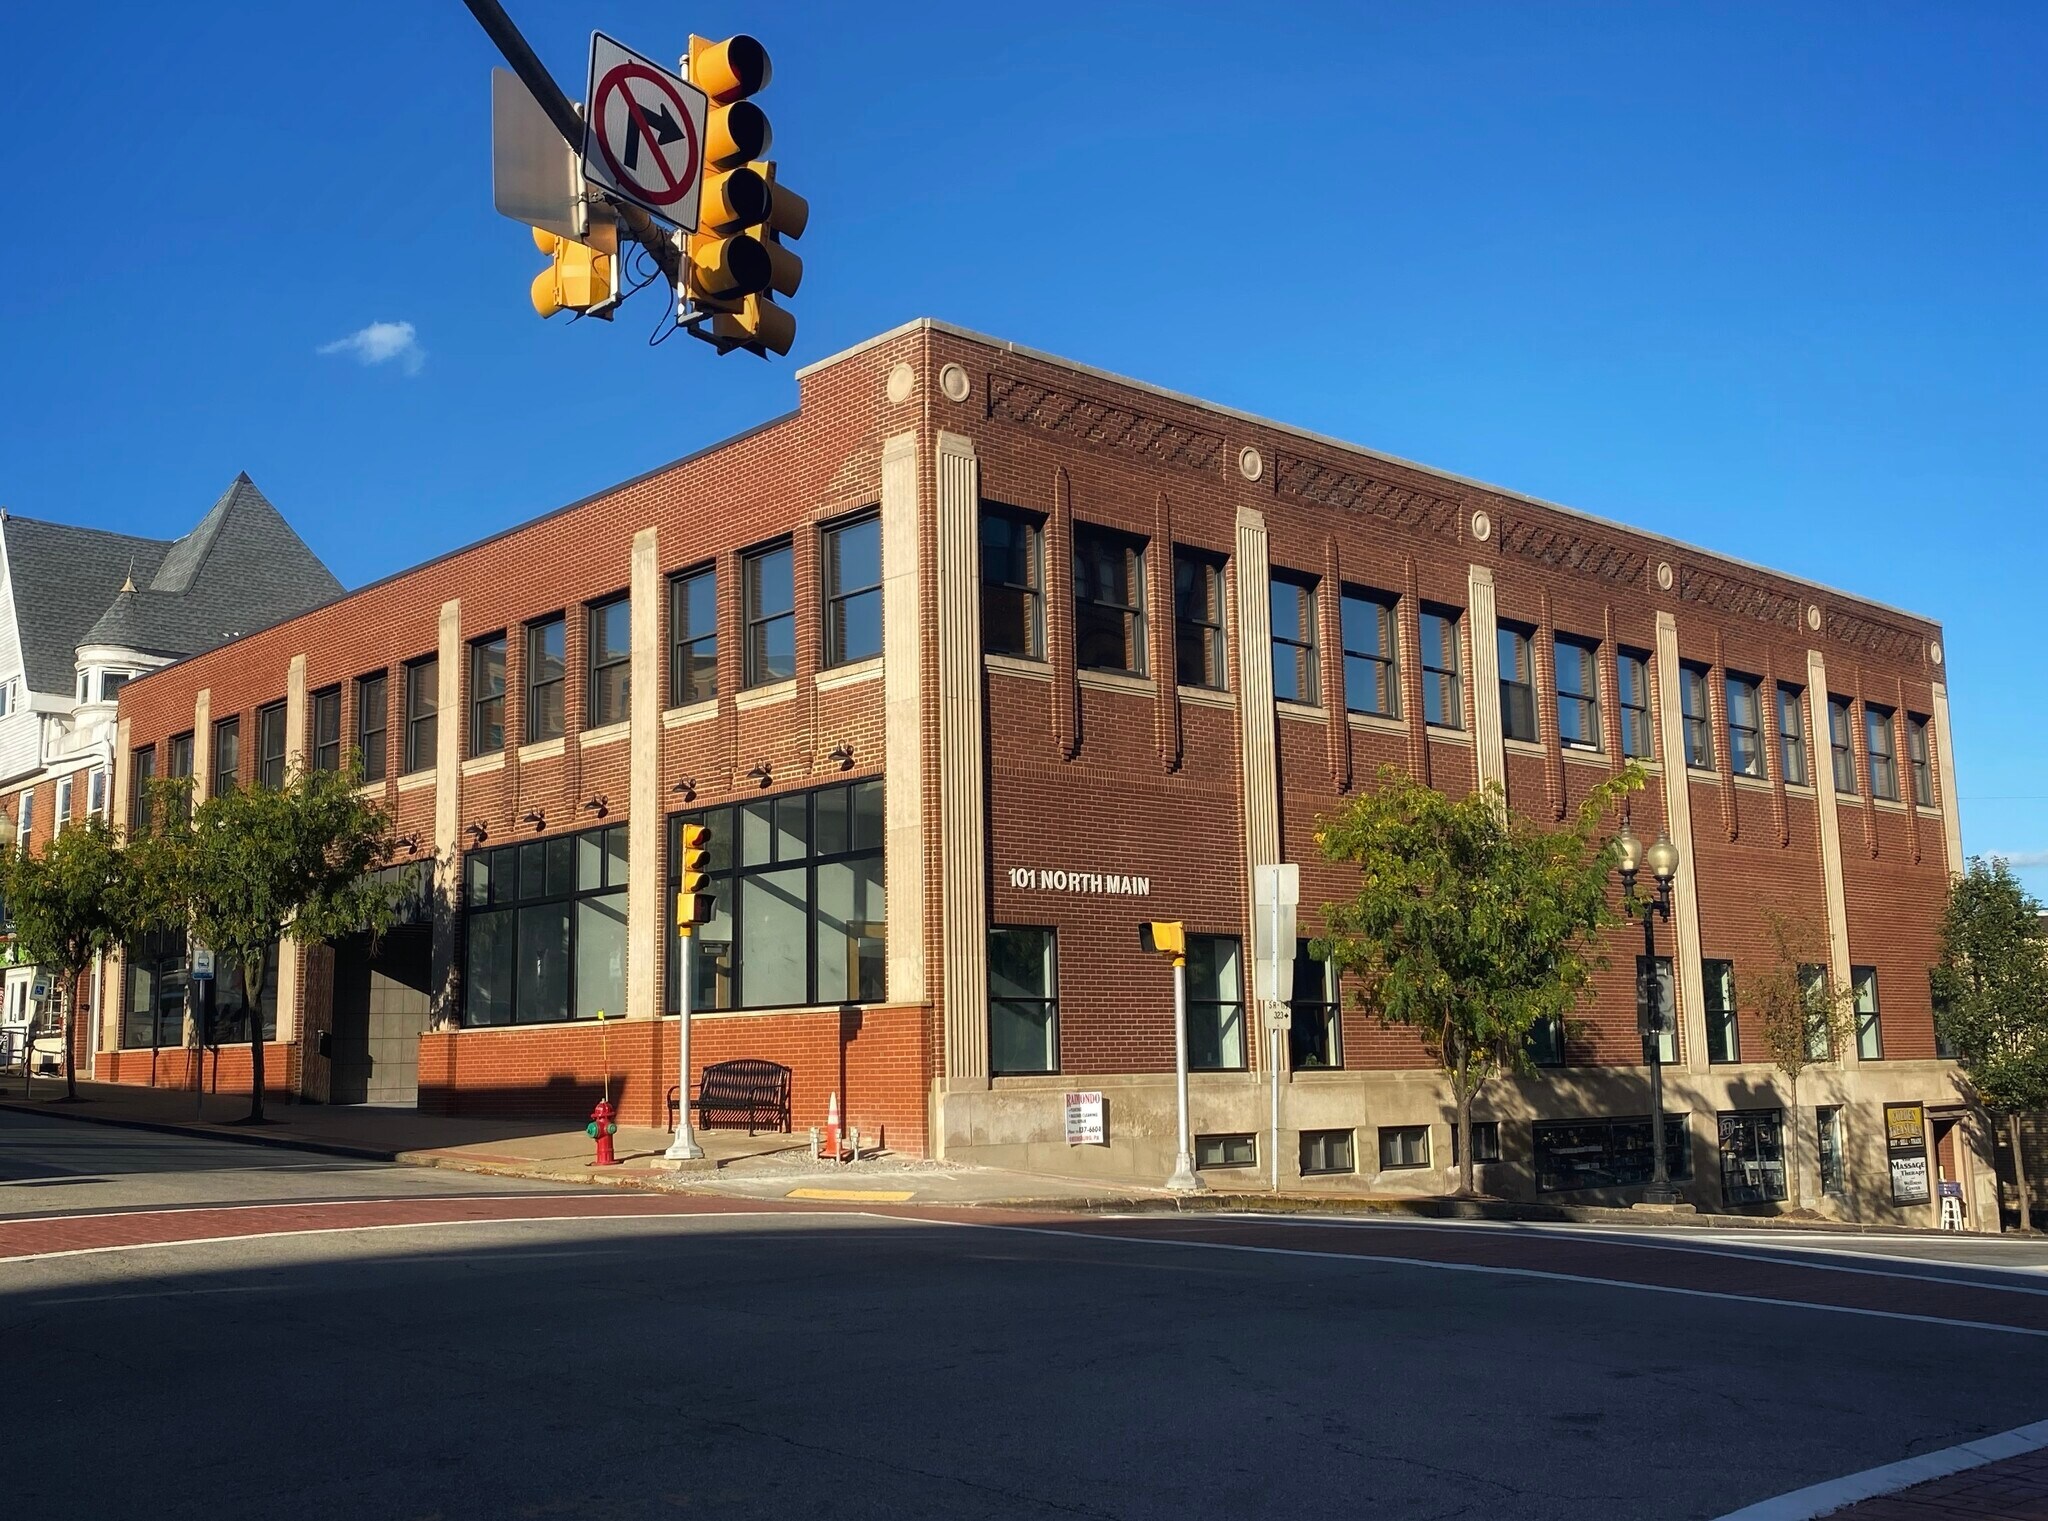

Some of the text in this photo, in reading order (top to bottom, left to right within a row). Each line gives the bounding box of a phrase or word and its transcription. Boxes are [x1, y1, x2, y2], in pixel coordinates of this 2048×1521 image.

[1008, 867, 1150, 896] 101 NORTH MAIN
[1891, 1161, 1924, 1170] MASSAGE
